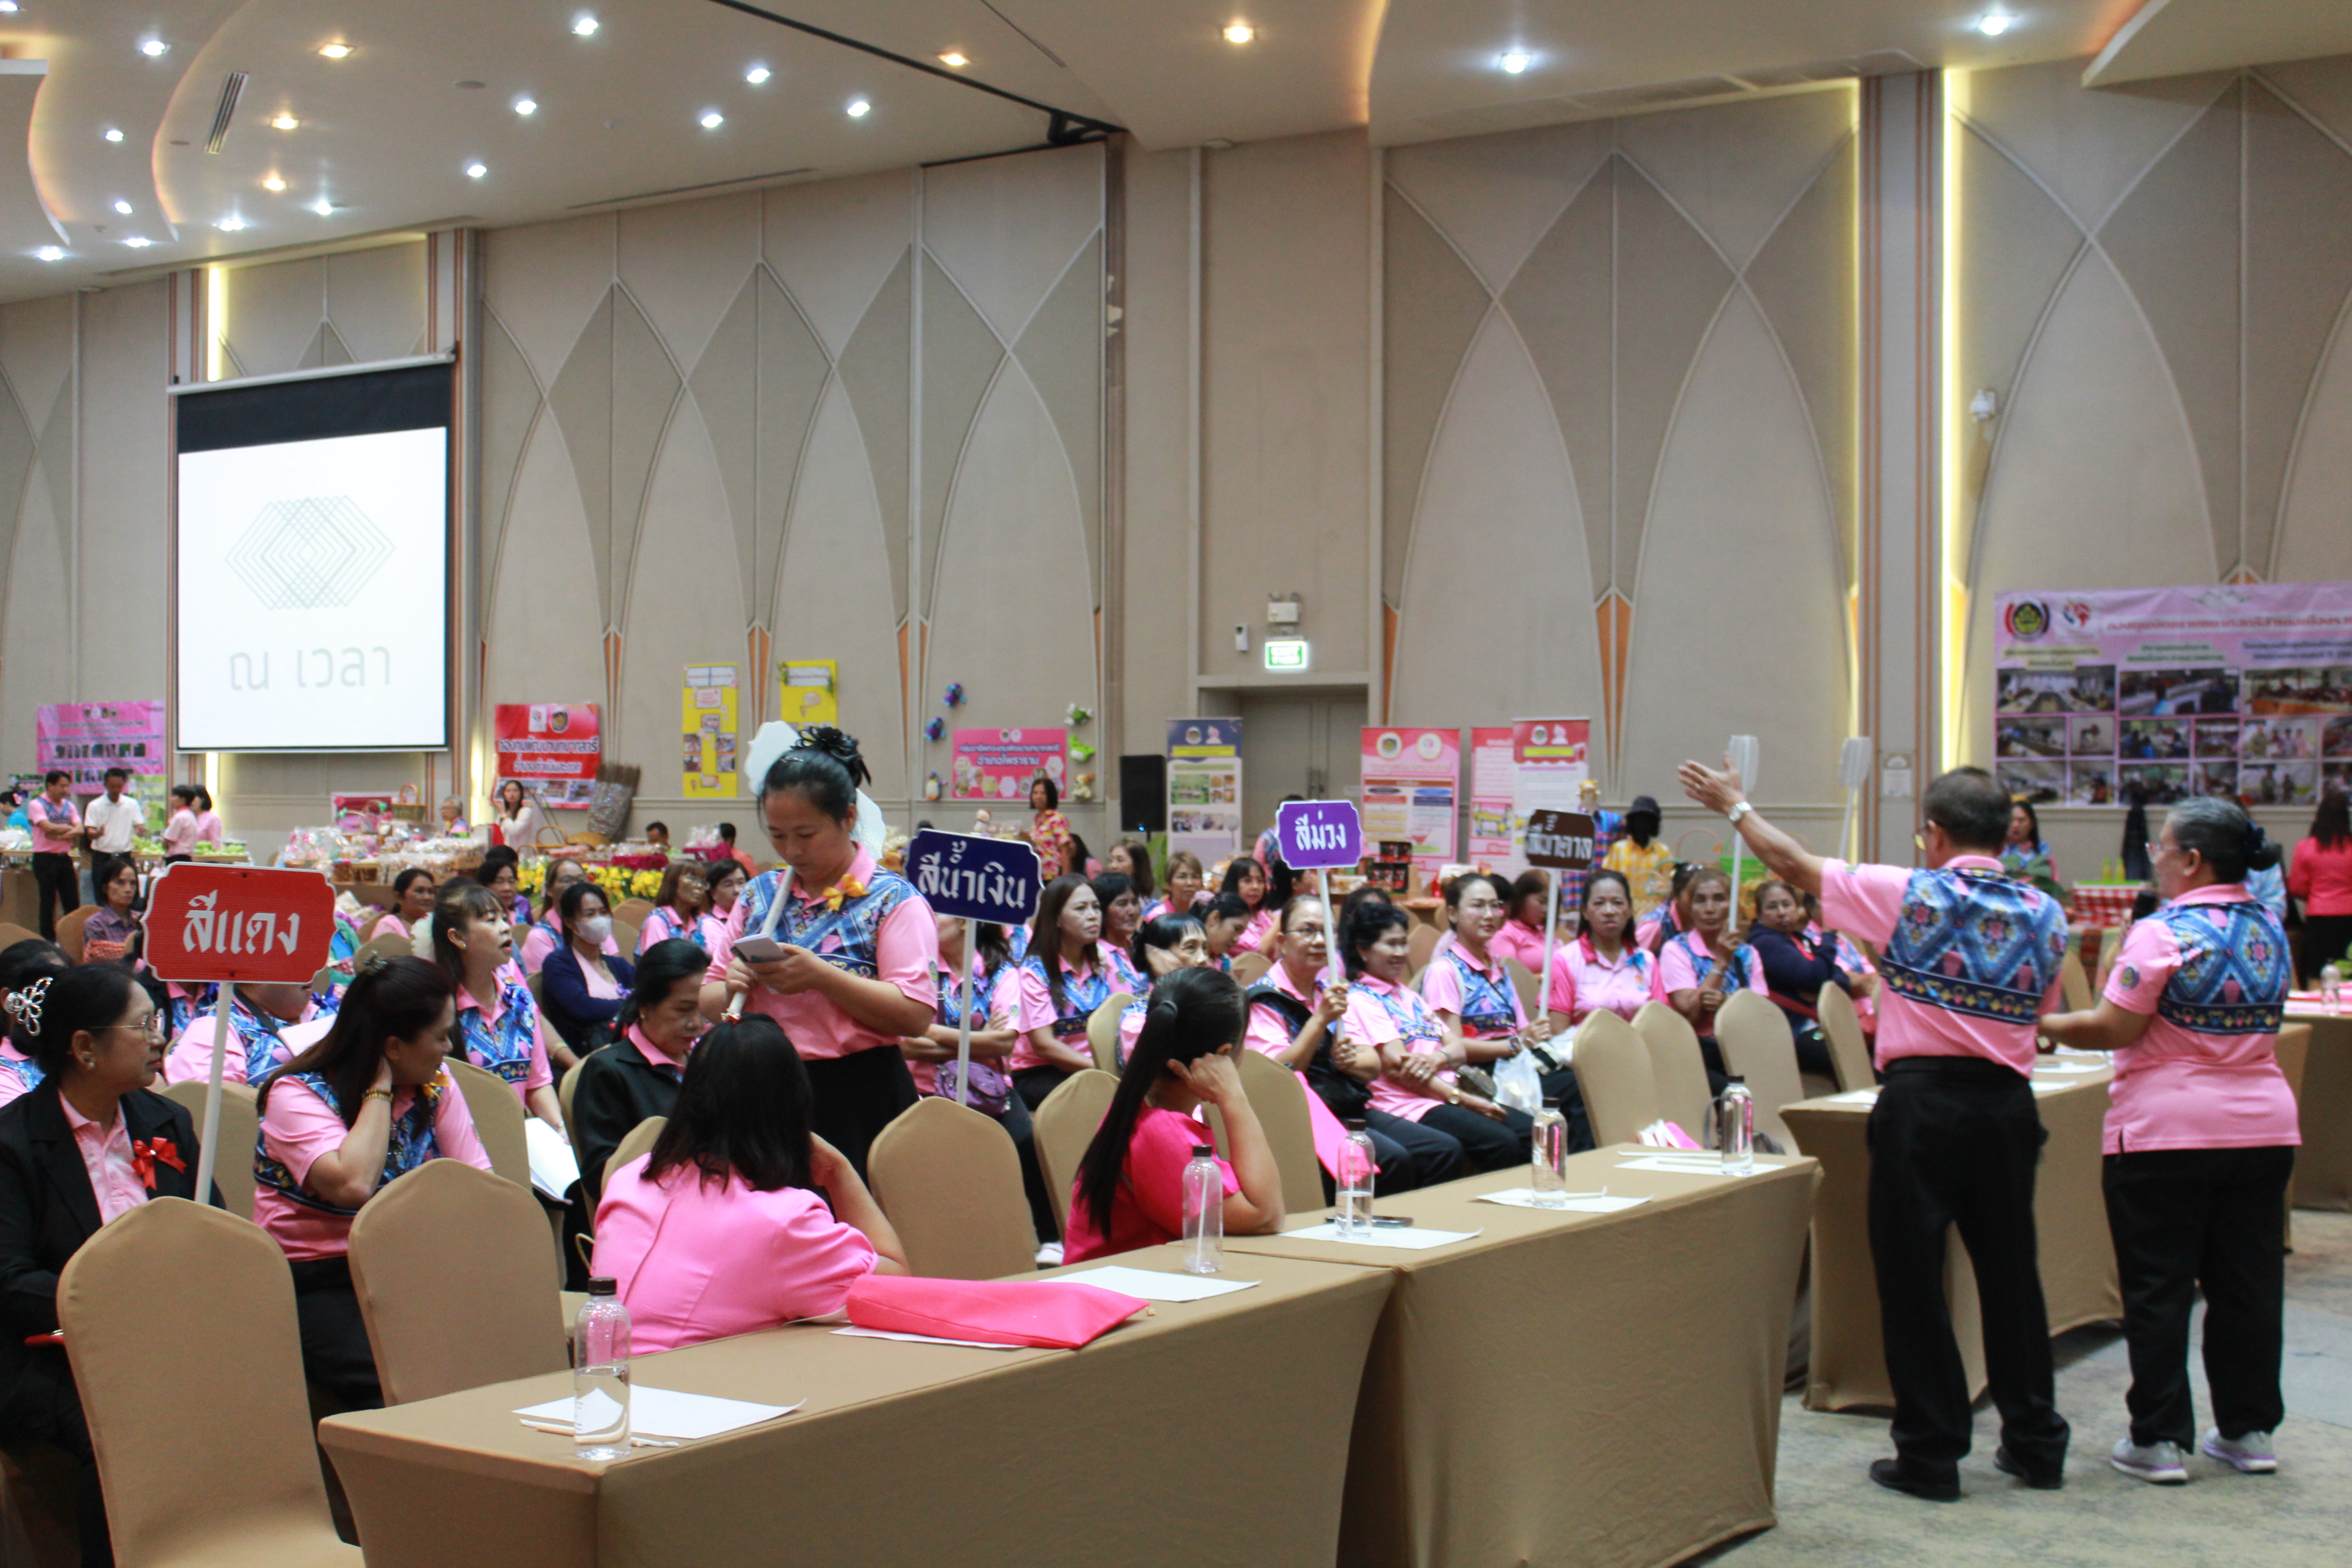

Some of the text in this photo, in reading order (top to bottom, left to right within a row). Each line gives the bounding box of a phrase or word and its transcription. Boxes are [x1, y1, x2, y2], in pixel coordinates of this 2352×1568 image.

[297, 646, 390, 688] เวลา
[1294, 809, 1347, 851] สีม่วง
[1526, 813, 1593, 860] สีน้ำตาล
[917, 840, 1026, 910] สีน้ำเงิน
[183, 889, 300, 955] สีแดง
